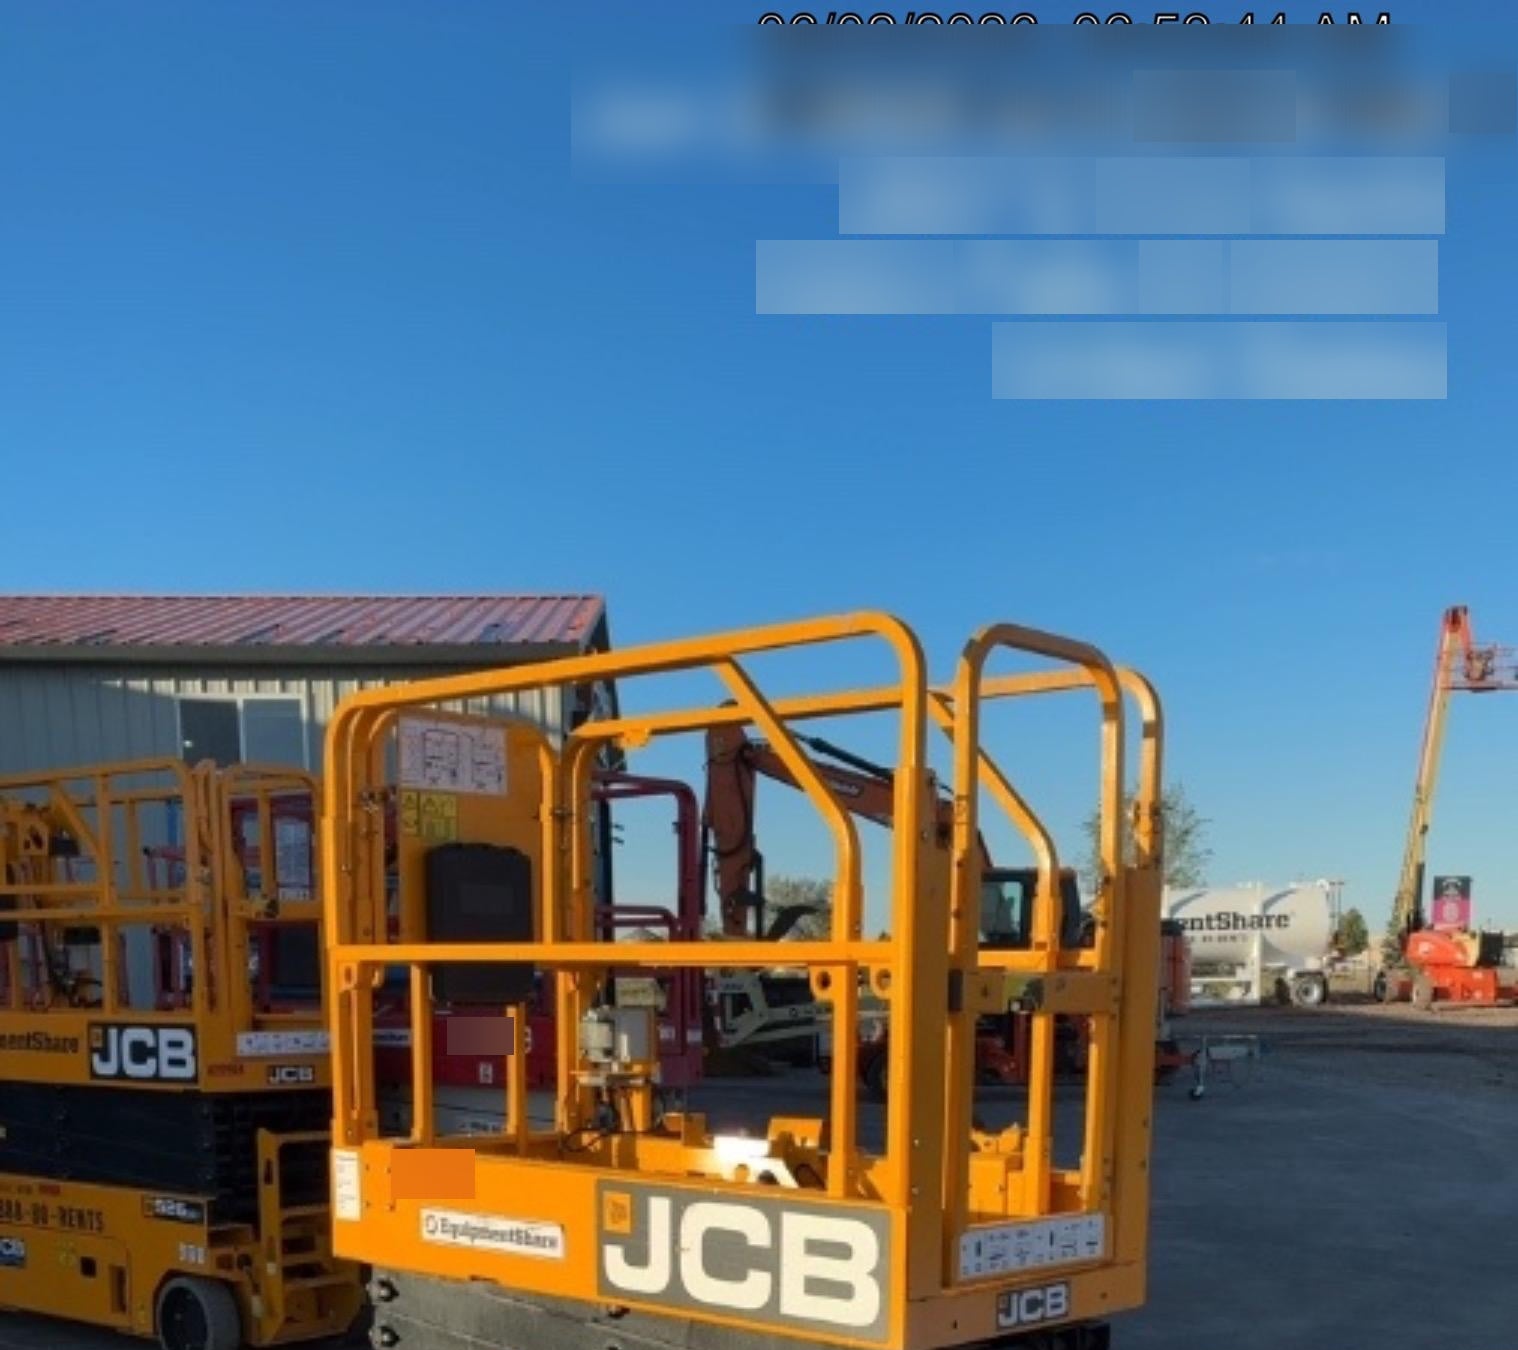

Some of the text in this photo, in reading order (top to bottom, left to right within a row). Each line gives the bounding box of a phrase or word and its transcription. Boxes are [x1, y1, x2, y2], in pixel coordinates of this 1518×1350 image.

[91, 1027, 196, 1078] JCB
[269, 1066, 313, 1084] JCB
[439, 1217, 559, 1249] EquipmentShare
[604, 1196, 881, 1327] JCB
[998, 1283, 1069, 1328] JCB
